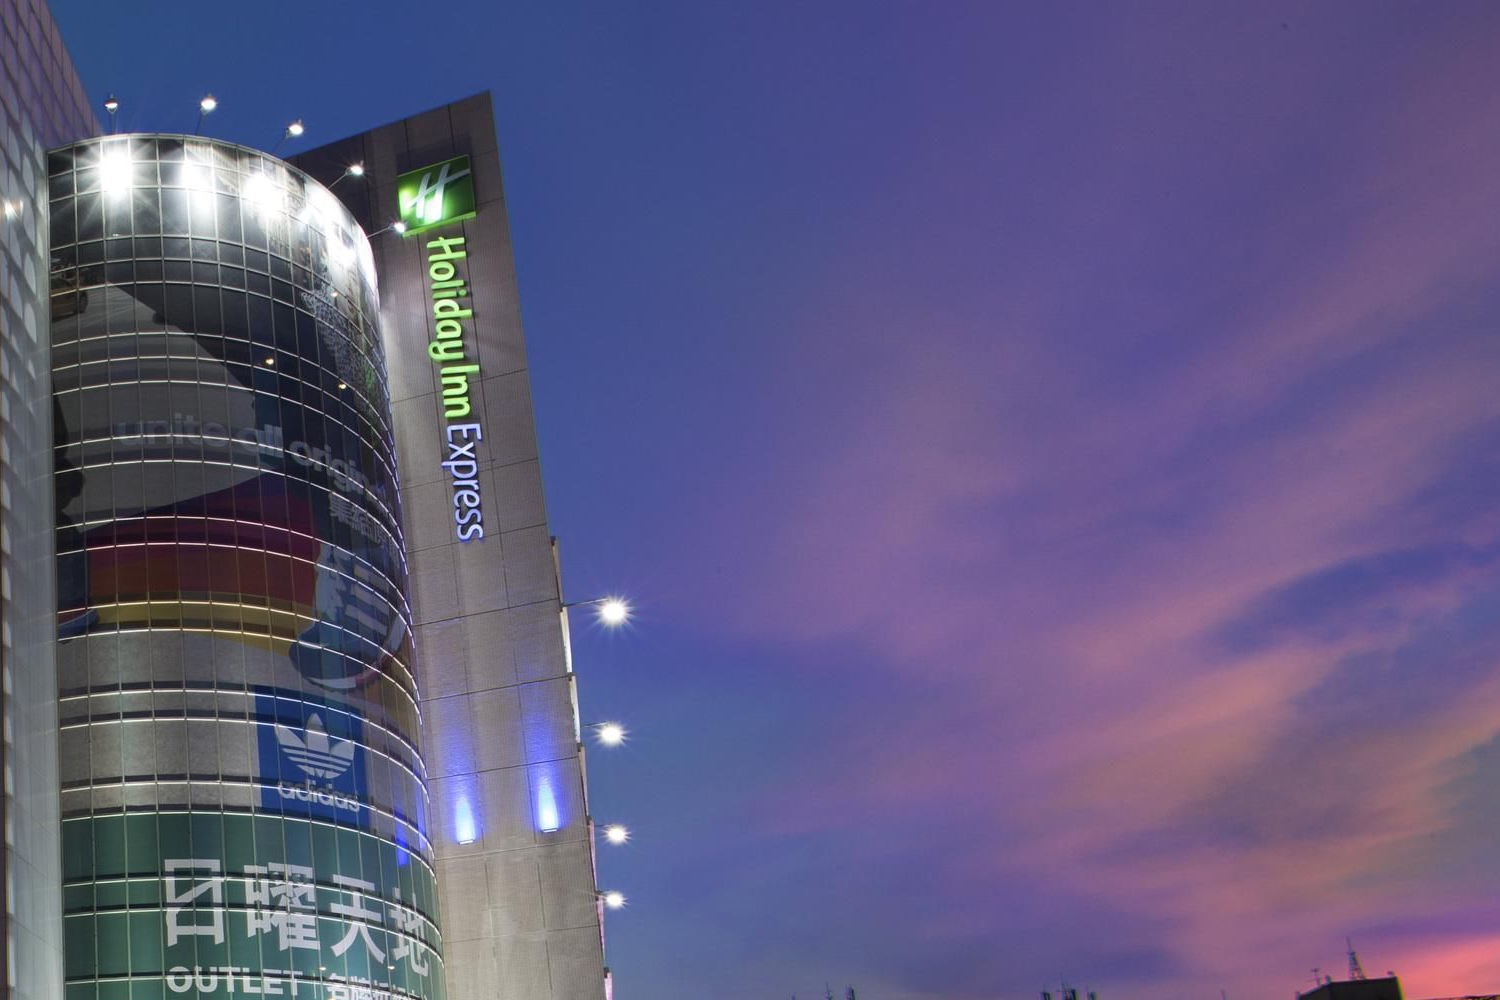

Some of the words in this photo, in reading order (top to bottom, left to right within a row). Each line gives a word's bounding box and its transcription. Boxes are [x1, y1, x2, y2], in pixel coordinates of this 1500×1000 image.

[426, 236, 473, 362] Holiday
[440, 364, 480, 418] Inn
[115, 413, 229, 448] unite
[240, 423, 284, 459] all
[442, 422, 484, 543] Express
[277, 778, 360, 812] adidas
[164, 858, 431, 977] 日曜天地
[166, 965, 304, 997] OUTLET
